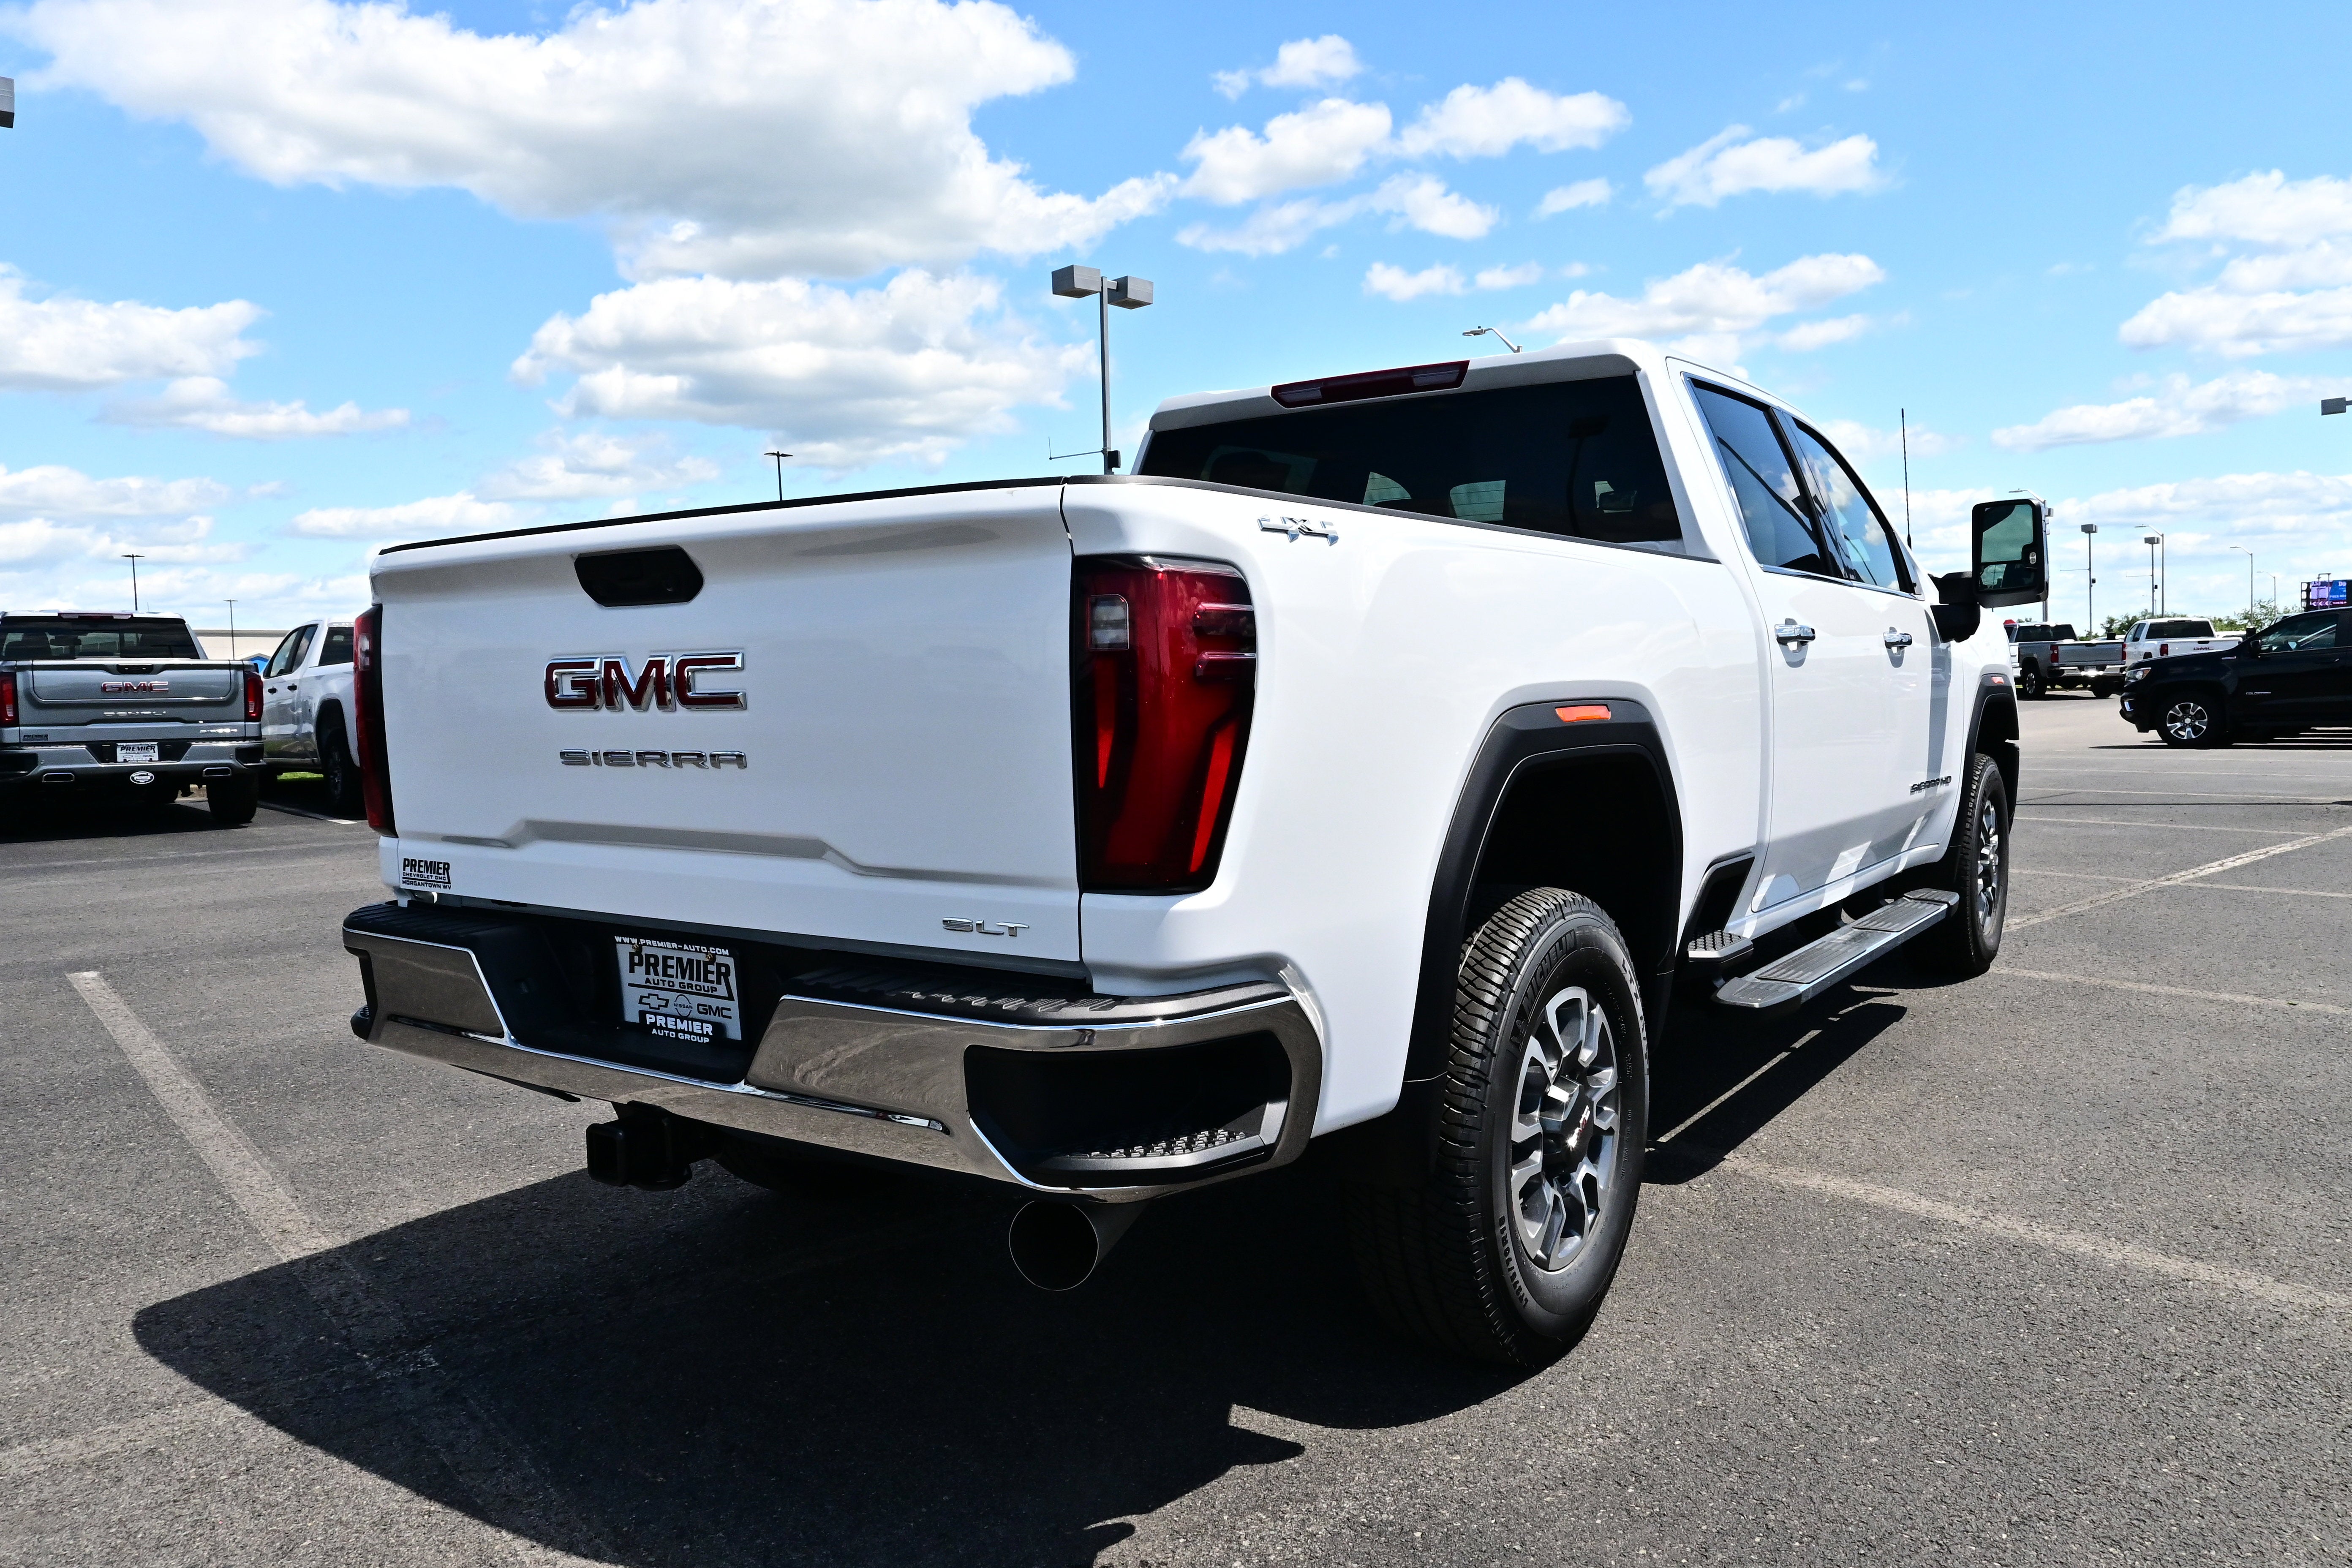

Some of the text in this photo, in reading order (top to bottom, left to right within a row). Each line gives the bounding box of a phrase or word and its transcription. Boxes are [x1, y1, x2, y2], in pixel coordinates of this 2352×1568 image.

[101, 681, 169, 693] GMC
[544, 652, 747, 712] GMC
[559, 749, 747, 769] SIERRA
[403, 858, 451, 879] PREMIER
[402, 879, 441, 889] MORGANTOWN
[942, 917, 1029, 937] SLT
[614, 936, 729, 956] WWW.PREMIER-AUTO.COM
[629, 951, 734, 993] PREMIER
[1522, 930, 1576, 1016] MICHELIN
[645, 977, 717, 993] AUTO GROUP
[697, 1003, 732, 1019] GMC
[646, 1014, 713, 1035] PREMIER
[652, 1029, 709, 1043] AUTO GROUP
